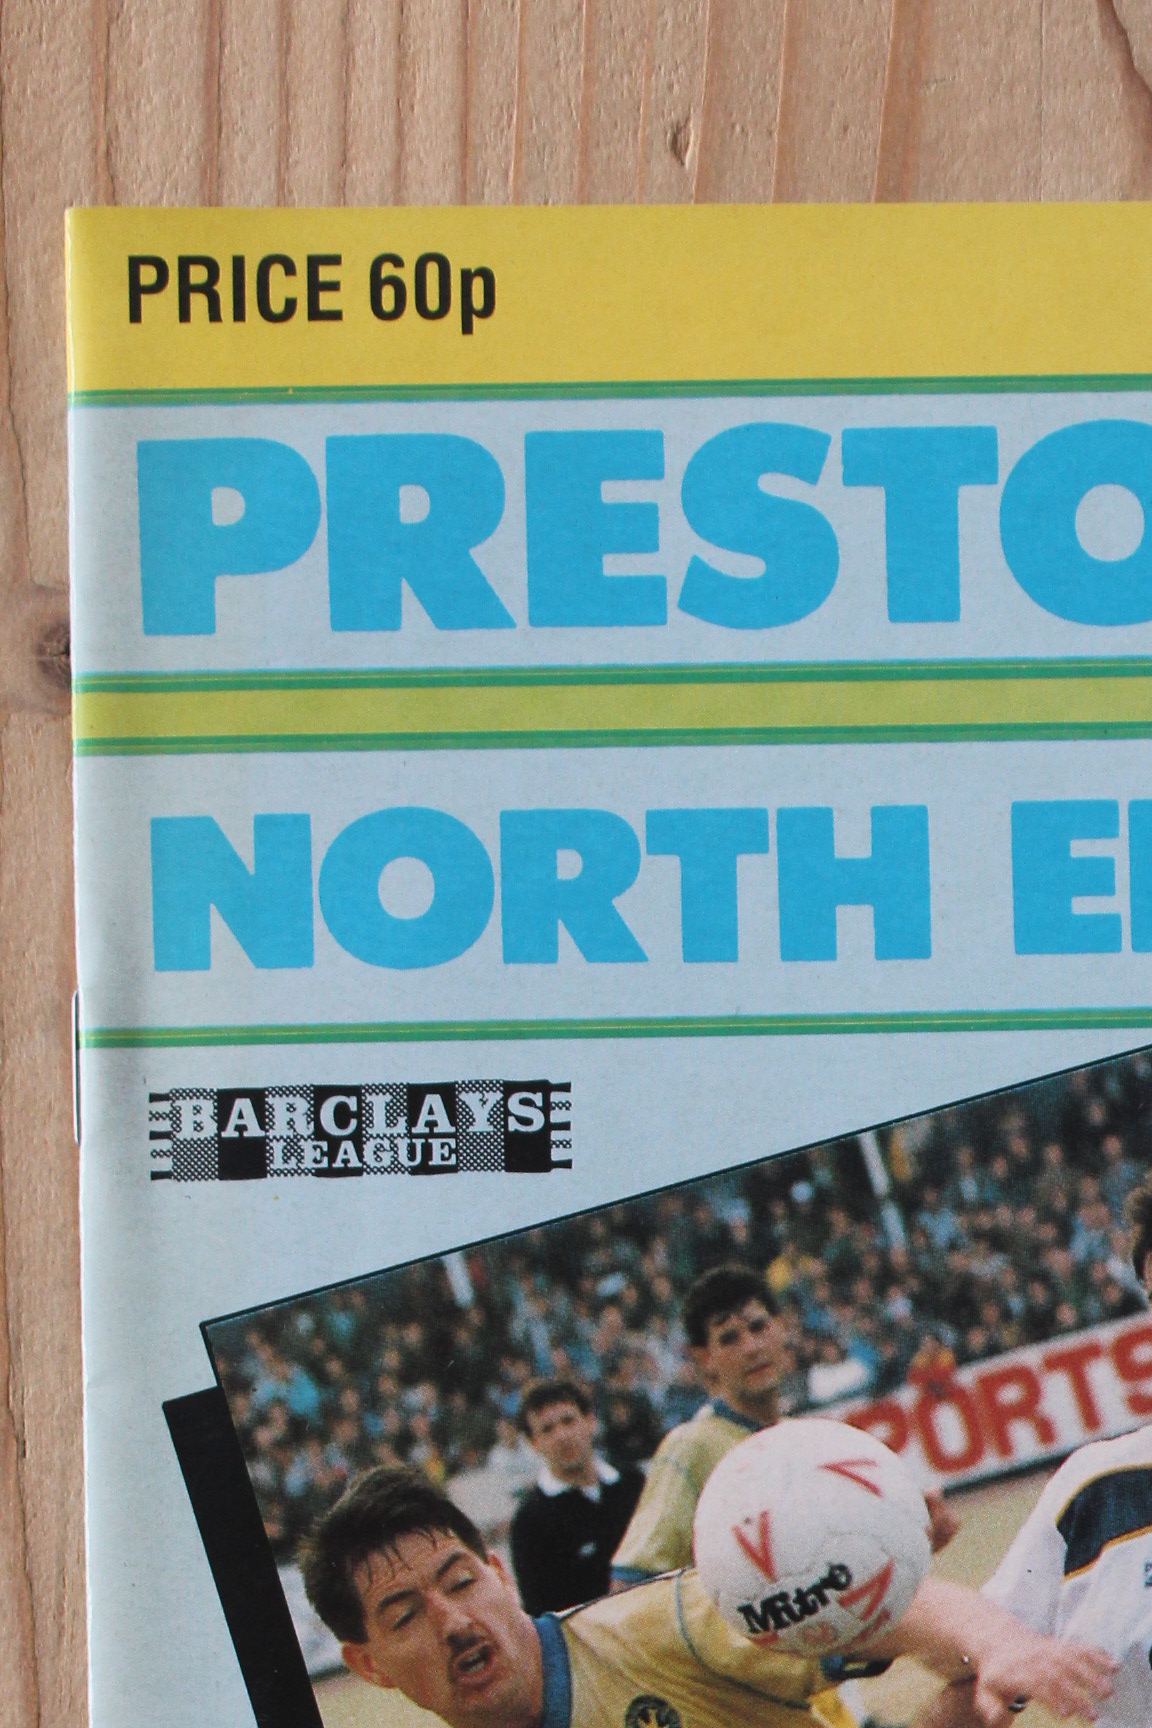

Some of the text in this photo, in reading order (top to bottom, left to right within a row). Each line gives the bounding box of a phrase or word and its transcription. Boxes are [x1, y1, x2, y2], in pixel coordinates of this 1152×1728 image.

[127, 252, 496, 336] PRICE 60p
[150, 804, 932, 972] NORTH
[174, 1090, 546, 1140] BARCLAYS
[271, 1137, 457, 1170] LEAGUE
